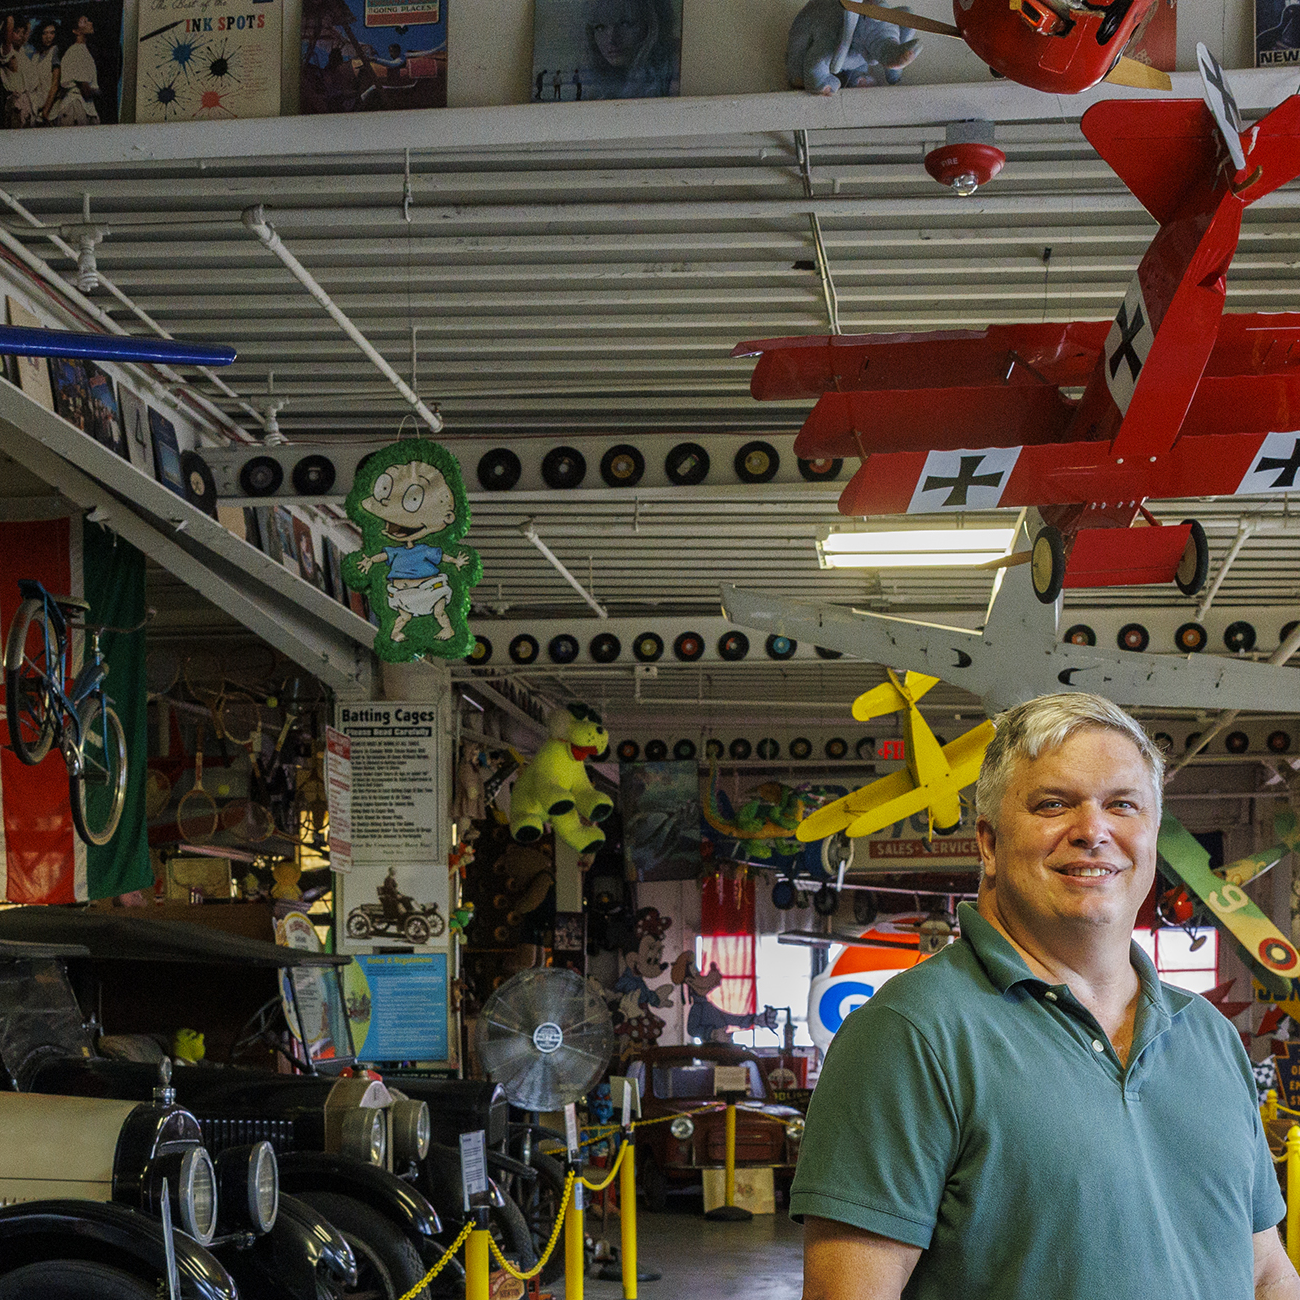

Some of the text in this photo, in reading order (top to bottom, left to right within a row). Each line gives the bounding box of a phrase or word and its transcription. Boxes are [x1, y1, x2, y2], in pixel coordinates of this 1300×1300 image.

[186, 14, 266, 33] INK SPOTS
[341, 708, 435, 725] Batting Cages
[877, 843, 914, 855] SALES
